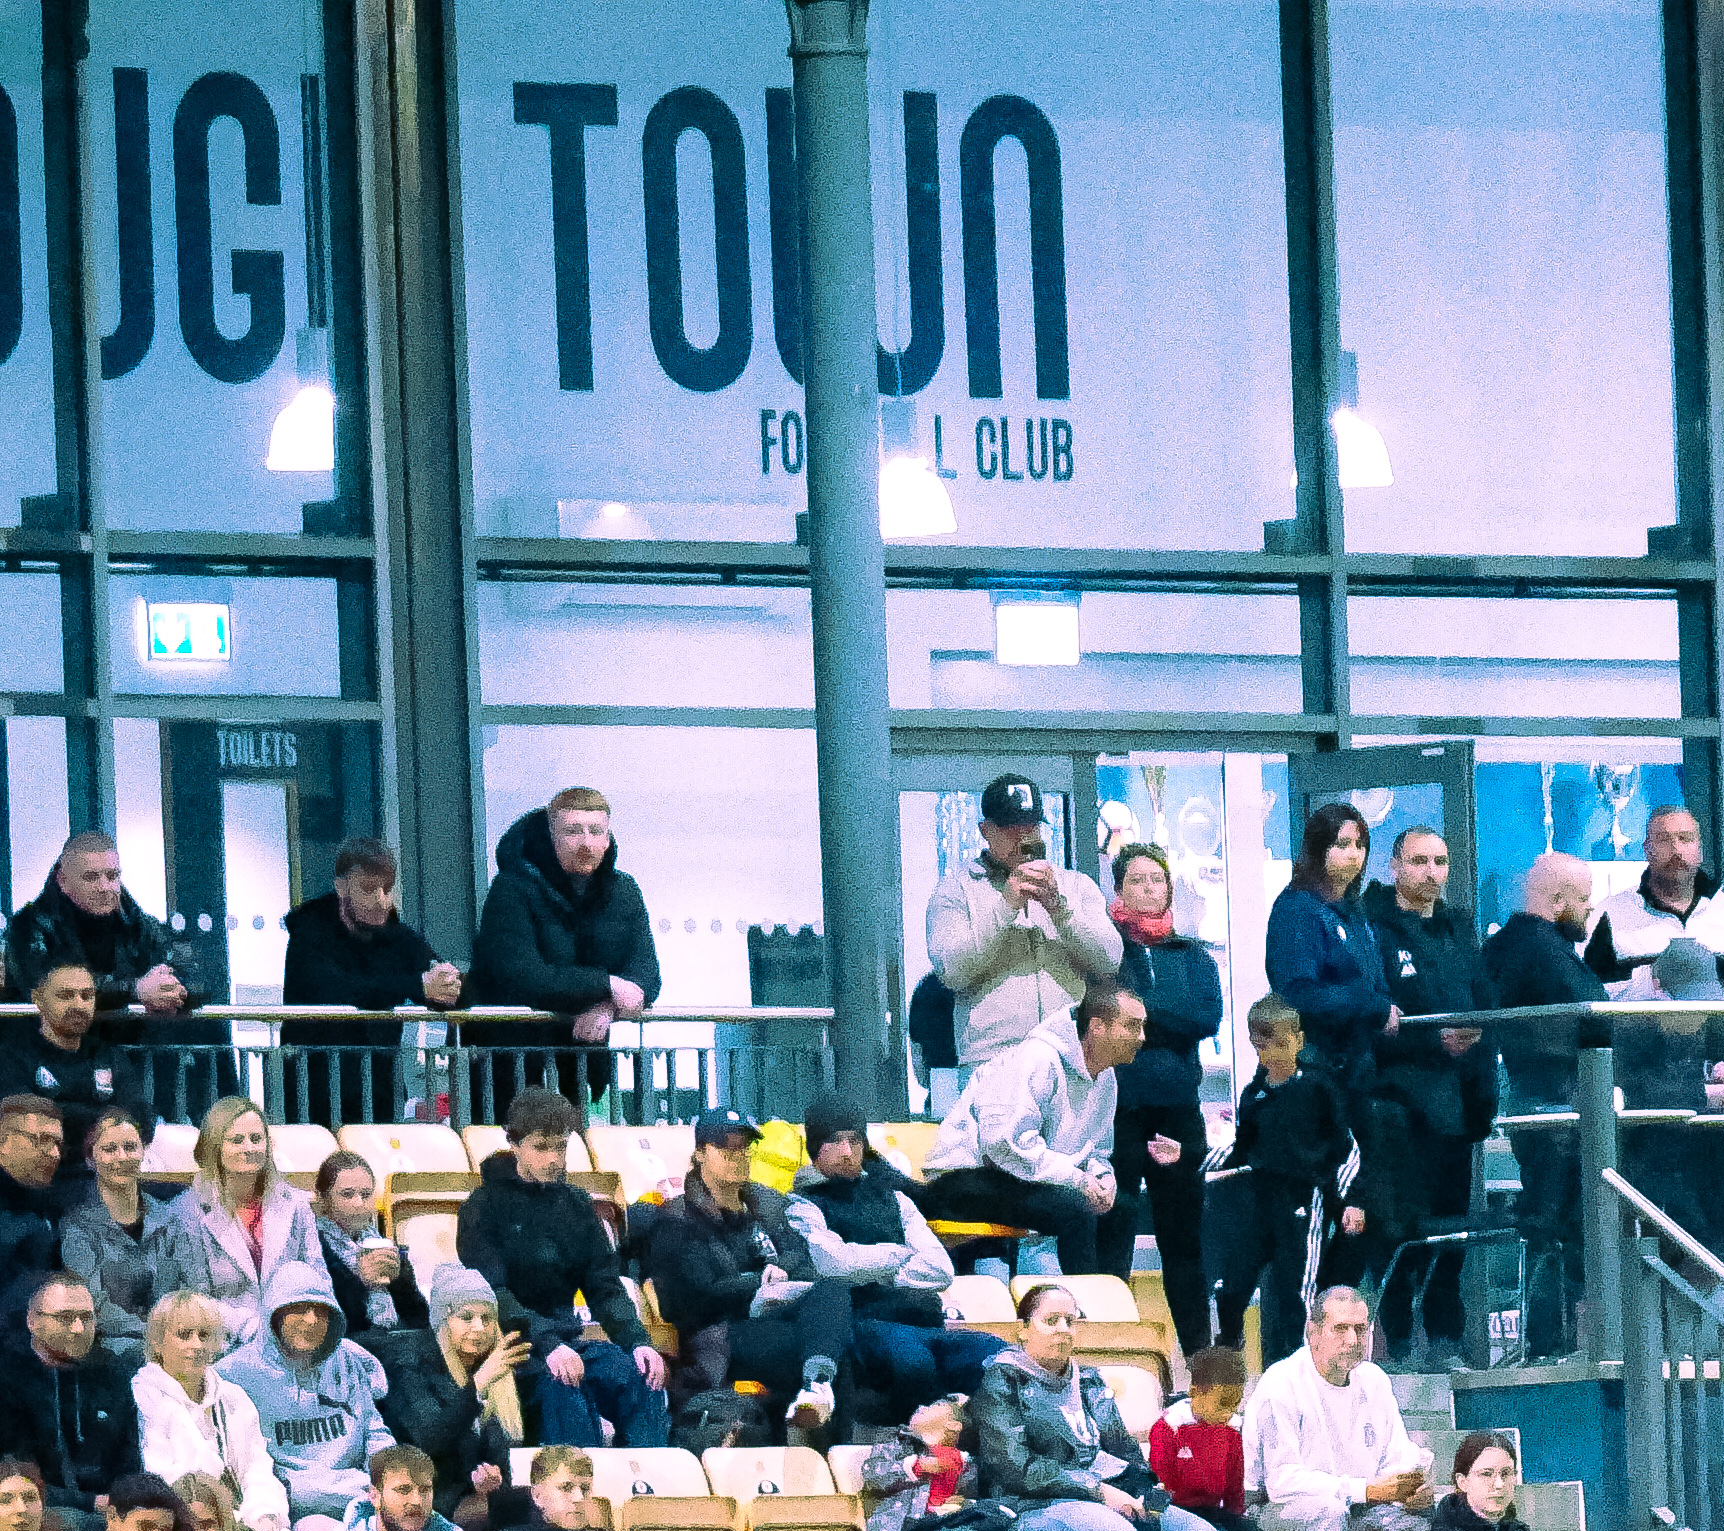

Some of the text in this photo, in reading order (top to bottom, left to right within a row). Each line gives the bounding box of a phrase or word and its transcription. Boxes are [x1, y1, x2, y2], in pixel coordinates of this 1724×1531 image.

[975, 415, 1074, 482] CLUB
[217, 731, 297, 767] TOILETS
[275, 1414, 346, 1447] PUMA
